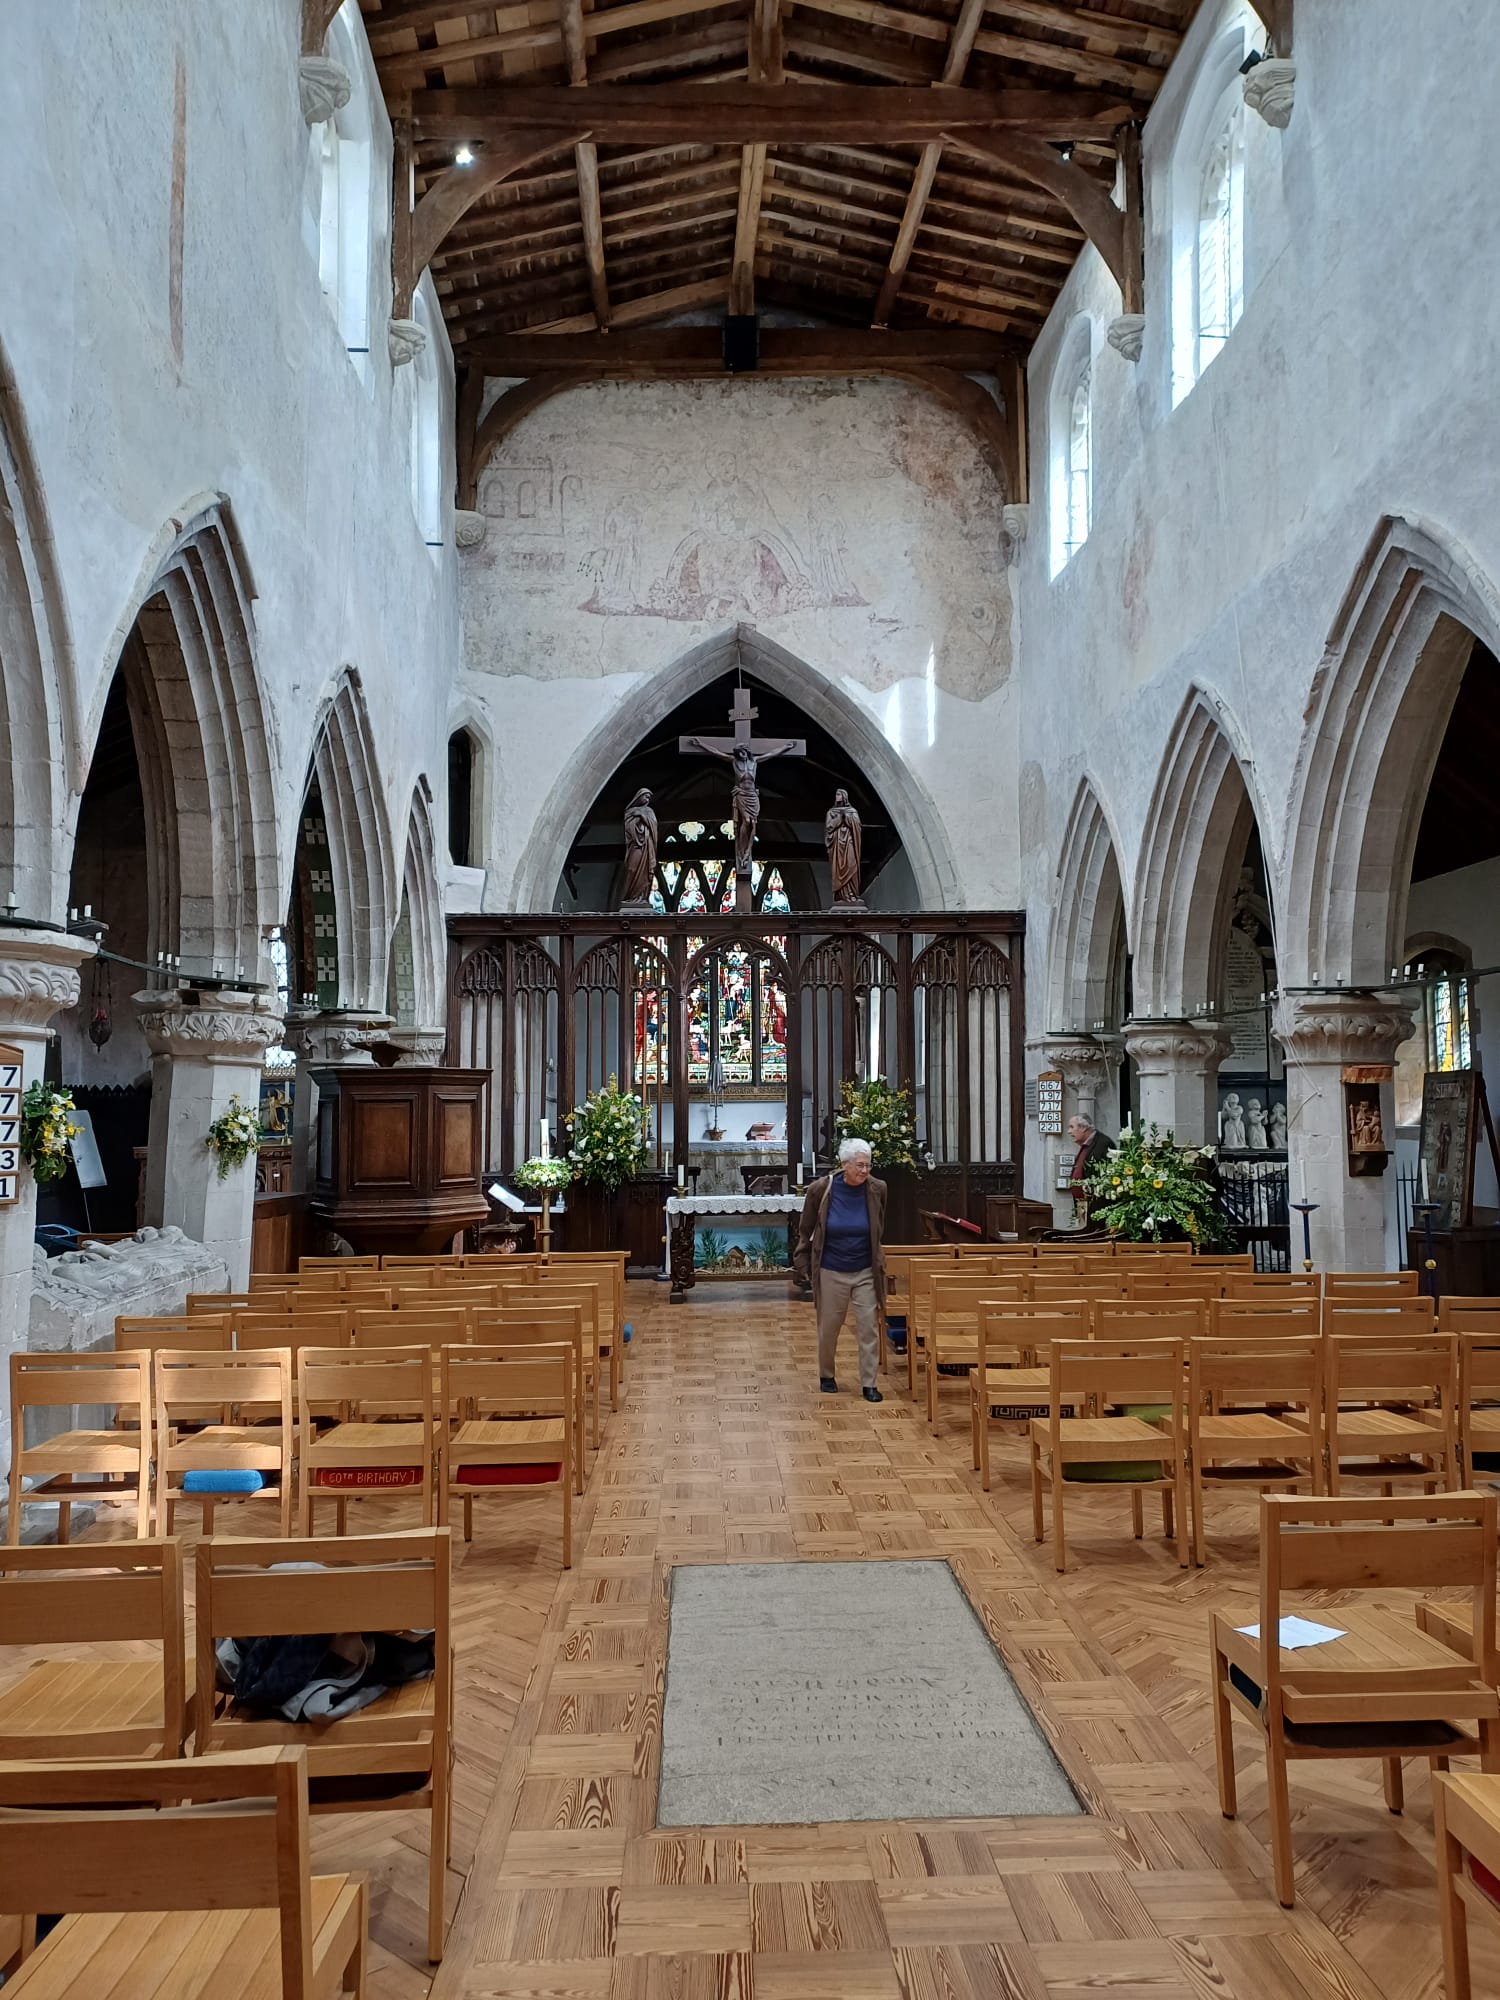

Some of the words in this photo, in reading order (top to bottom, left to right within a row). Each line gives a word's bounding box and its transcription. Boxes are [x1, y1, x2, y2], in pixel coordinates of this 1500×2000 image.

[3, 1066, 18, 1087] 7
[1040, 1081, 1060, 1090] 667
[1041, 1091, 1060, 1100] 197
[0, 1094, 16, 1114] 7
[1040, 1102, 1060, 1111] 717
[1039, 1112, 1060, 1121] 763
[1, 1121, 16, 1142] 7
[1040, 1123, 1060, 1132] 221
[0, 1150, 15, 1170] 3
[357, 1471, 407, 1484] BIRTHDAY
